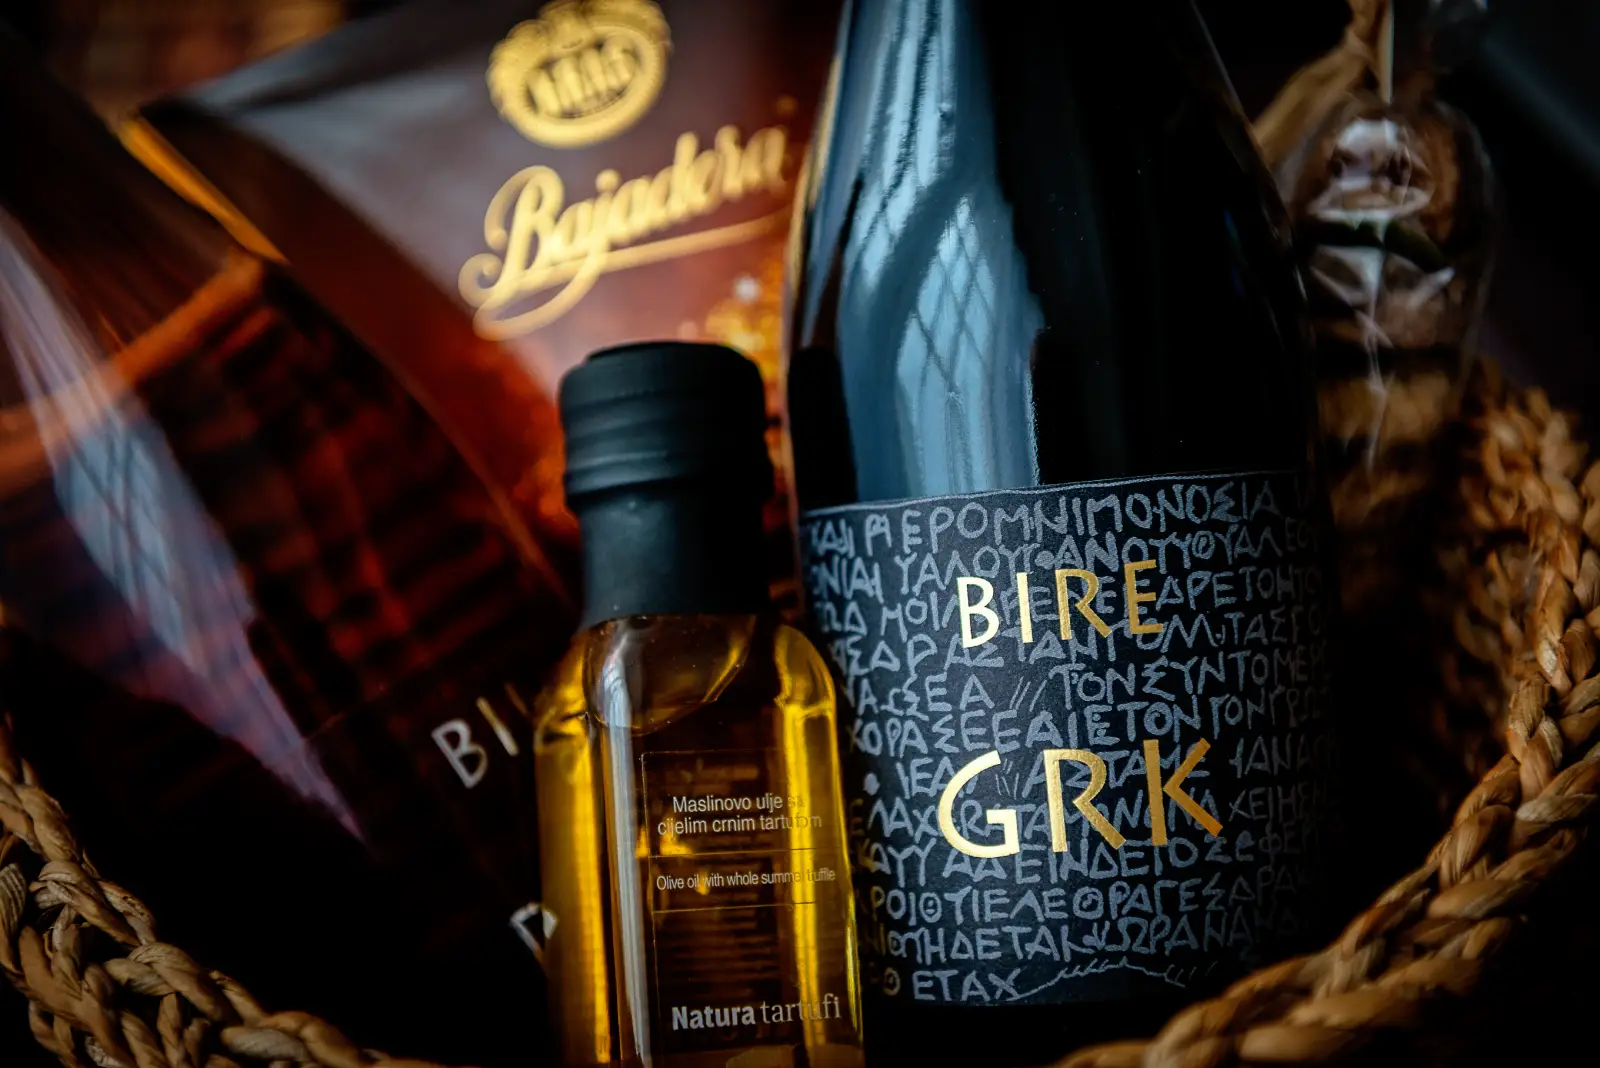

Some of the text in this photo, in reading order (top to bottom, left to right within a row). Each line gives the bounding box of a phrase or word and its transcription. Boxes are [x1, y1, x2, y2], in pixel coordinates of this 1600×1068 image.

[957, 559, 1163, 648] BIRE
[673, 795, 751, 813] Maslinovo
[756, 793, 783, 811] ulje
[938, 738, 1223, 858] GRK
[657, 813, 822, 838] cijelim crnim tartufom
[656, 874, 684, 890] Olive
[687, 874, 700, 888] oil
[701, 873, 724, 888] with
[727, 871, 758, 886] whole
[671, 993, 842, 1031] Natura tartufi
